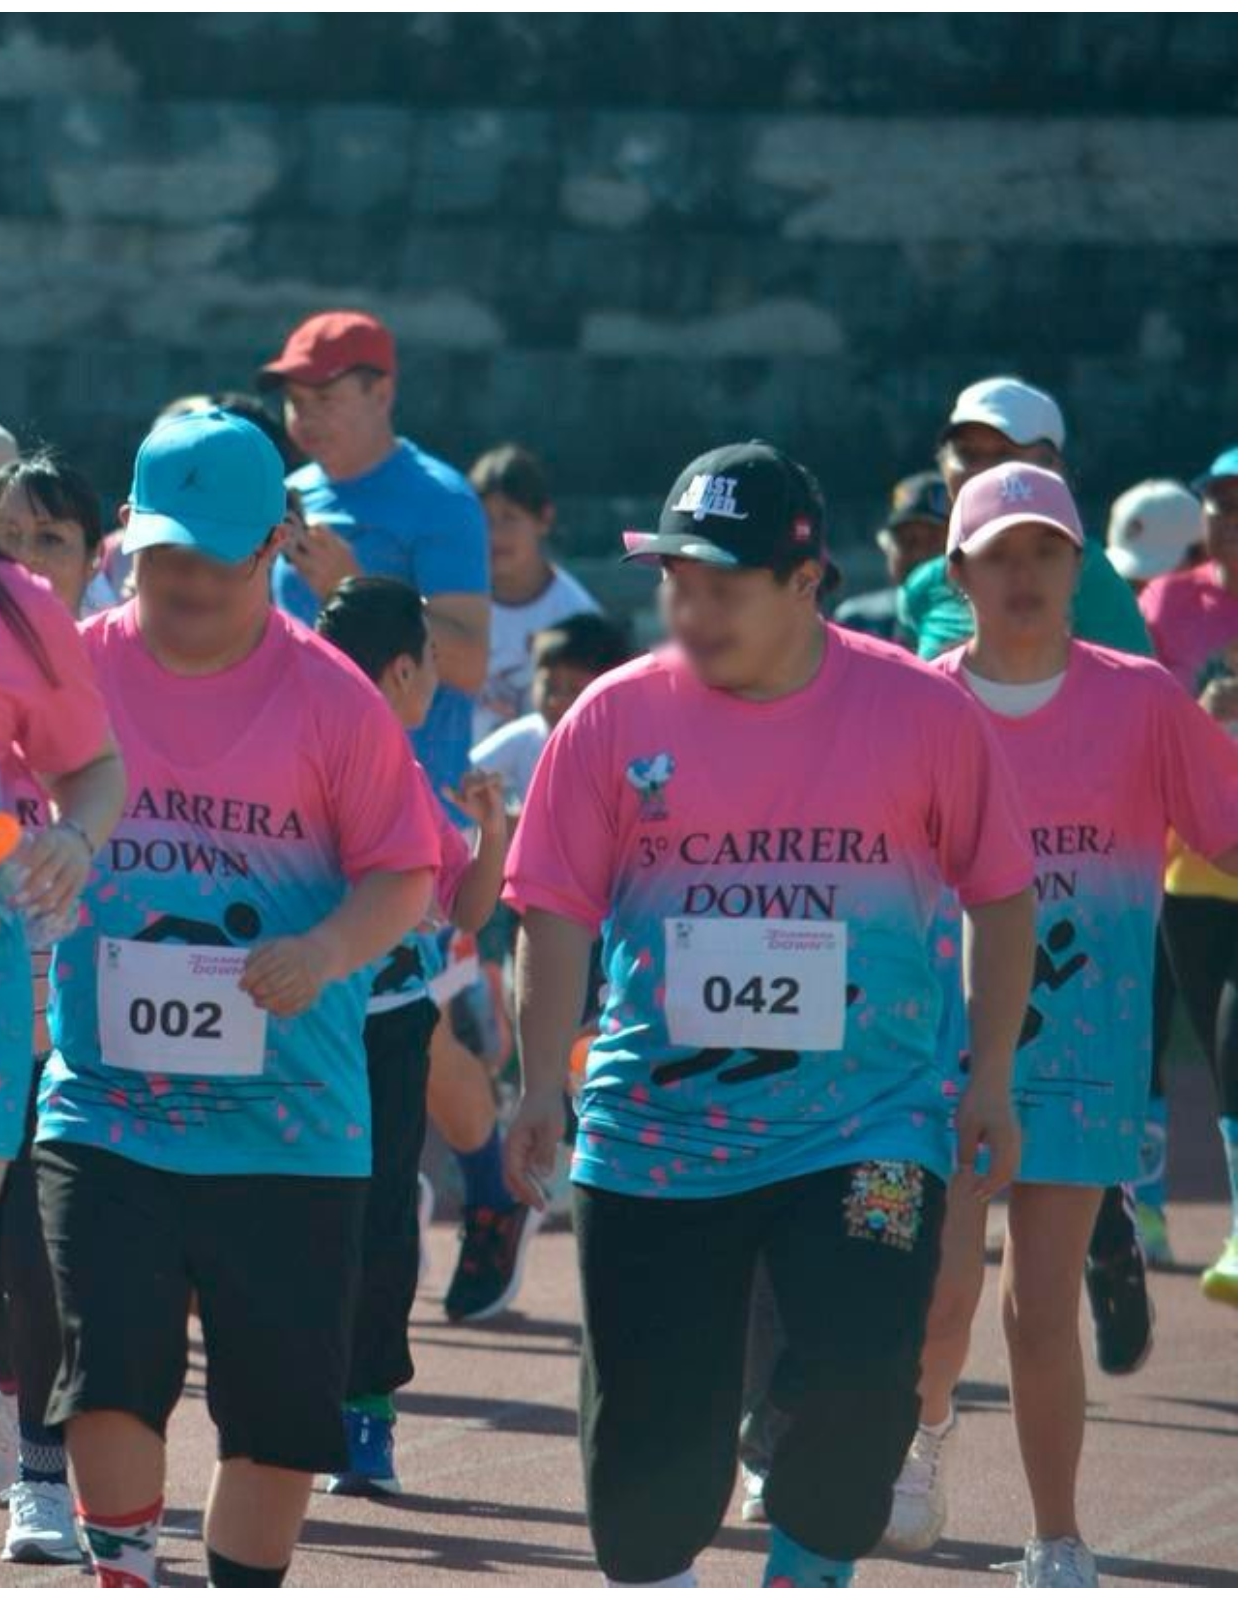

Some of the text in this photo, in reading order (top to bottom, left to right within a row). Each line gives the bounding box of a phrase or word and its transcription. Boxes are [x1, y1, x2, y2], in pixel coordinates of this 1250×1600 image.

[687, 475, 738, 497] ST
[122, 785, 307, 840] ARRERA
[109, 836, 250, 880] DOWN
[678, 827, 892, 866] CARRERA
[681, 882, 840, 920] DOWN
[702, 975, 800, 1015] 042
[129, 997, 224, 1040] 002
